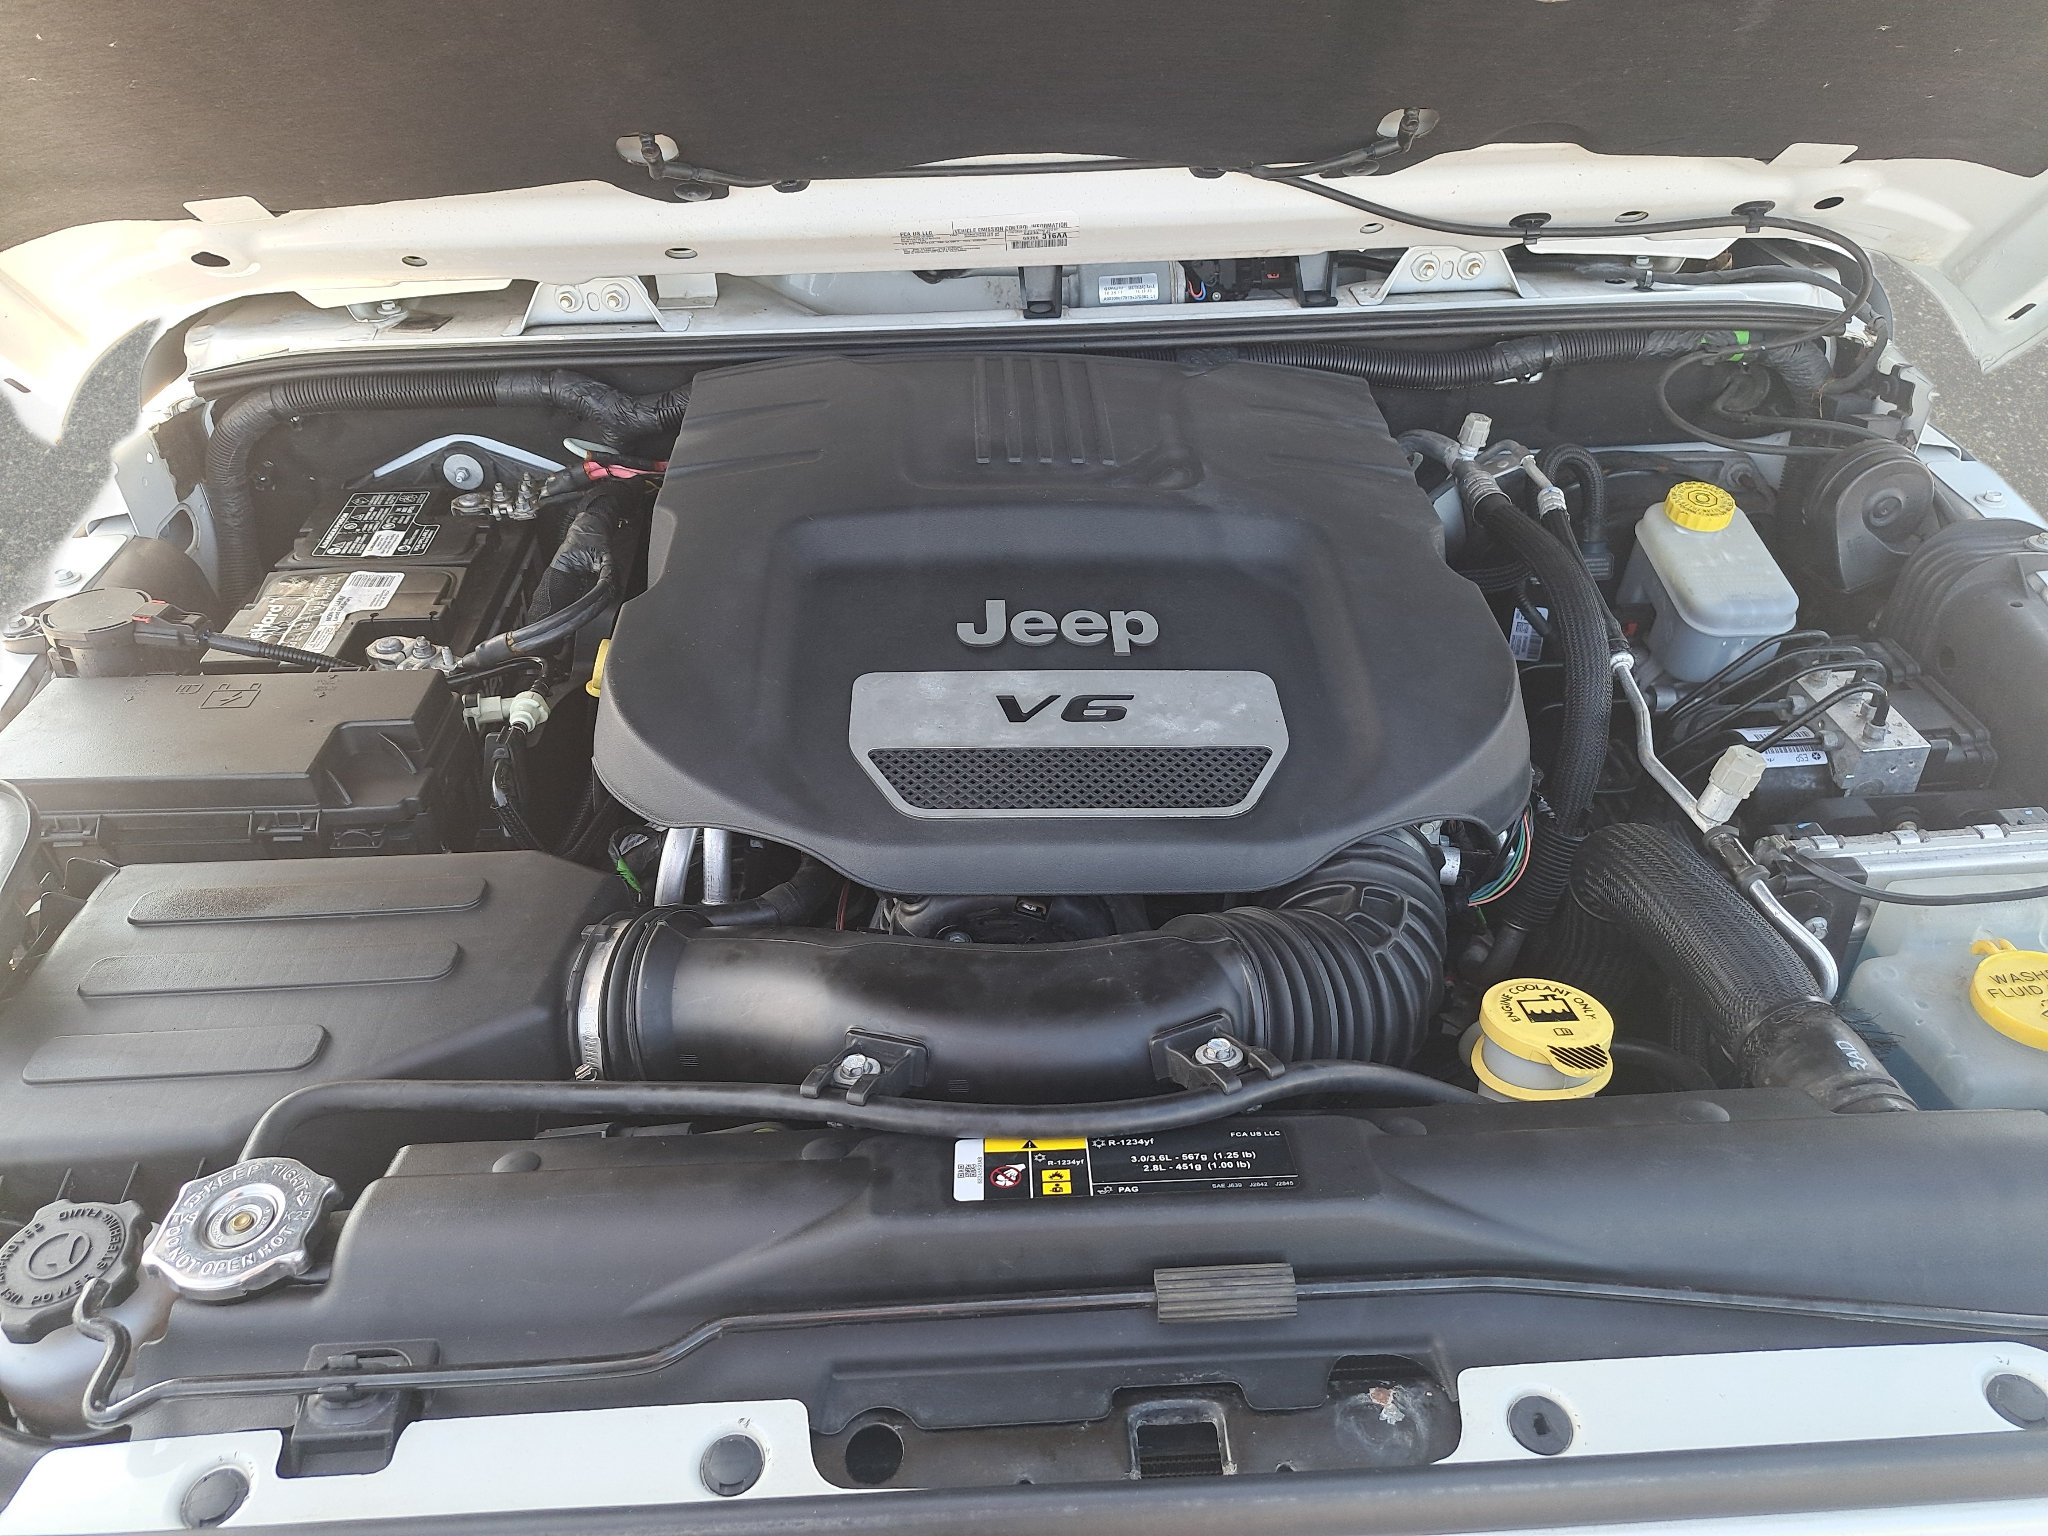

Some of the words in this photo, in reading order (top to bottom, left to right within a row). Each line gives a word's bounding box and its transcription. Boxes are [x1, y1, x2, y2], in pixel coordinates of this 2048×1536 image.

[956, 599, 1159, 656] Jeep
[995, 694, 1135, 723] V6
[1988, 969, 2048, 985] WASH
[1509, 984, 1570, 996] COOLANT
[1986, 985, 2043, 999] FLUID
[1500, 993, 1521, 1023] ENGINE
[1573, 997, 1597, 1020] ONLY
[1108, 1137, 1155, 1147] R-1234yf
[1047, 1158, 1085, 1166] R-1234yf
[1130, 1154, 1173, 1163] 3.0/3.6L
[1181, 1153, 1208, 1161] 567g
[1213, 1151, 1240, 1161] (1.25
[1241, 1150, 1257, 1160] lb)
[1143, 1164, 1167, 1172] 2.8L
[1175, 1163, 1202, 1171] 451g
[1207, 1161, 1234, 1171] (1.00
[1235, 1160, 1251, 1170] lb)
[202, 1164, 262, 1194] KEEP
[273, 1163, 312, 1191] TIGHT
[1118, 1185, 1139, 1193] PAG
[168, 1246, 202, 1273] NOT
[200, 1251, 255, 1275] OPEN
[258, 1225, 296, 1258] HOT
